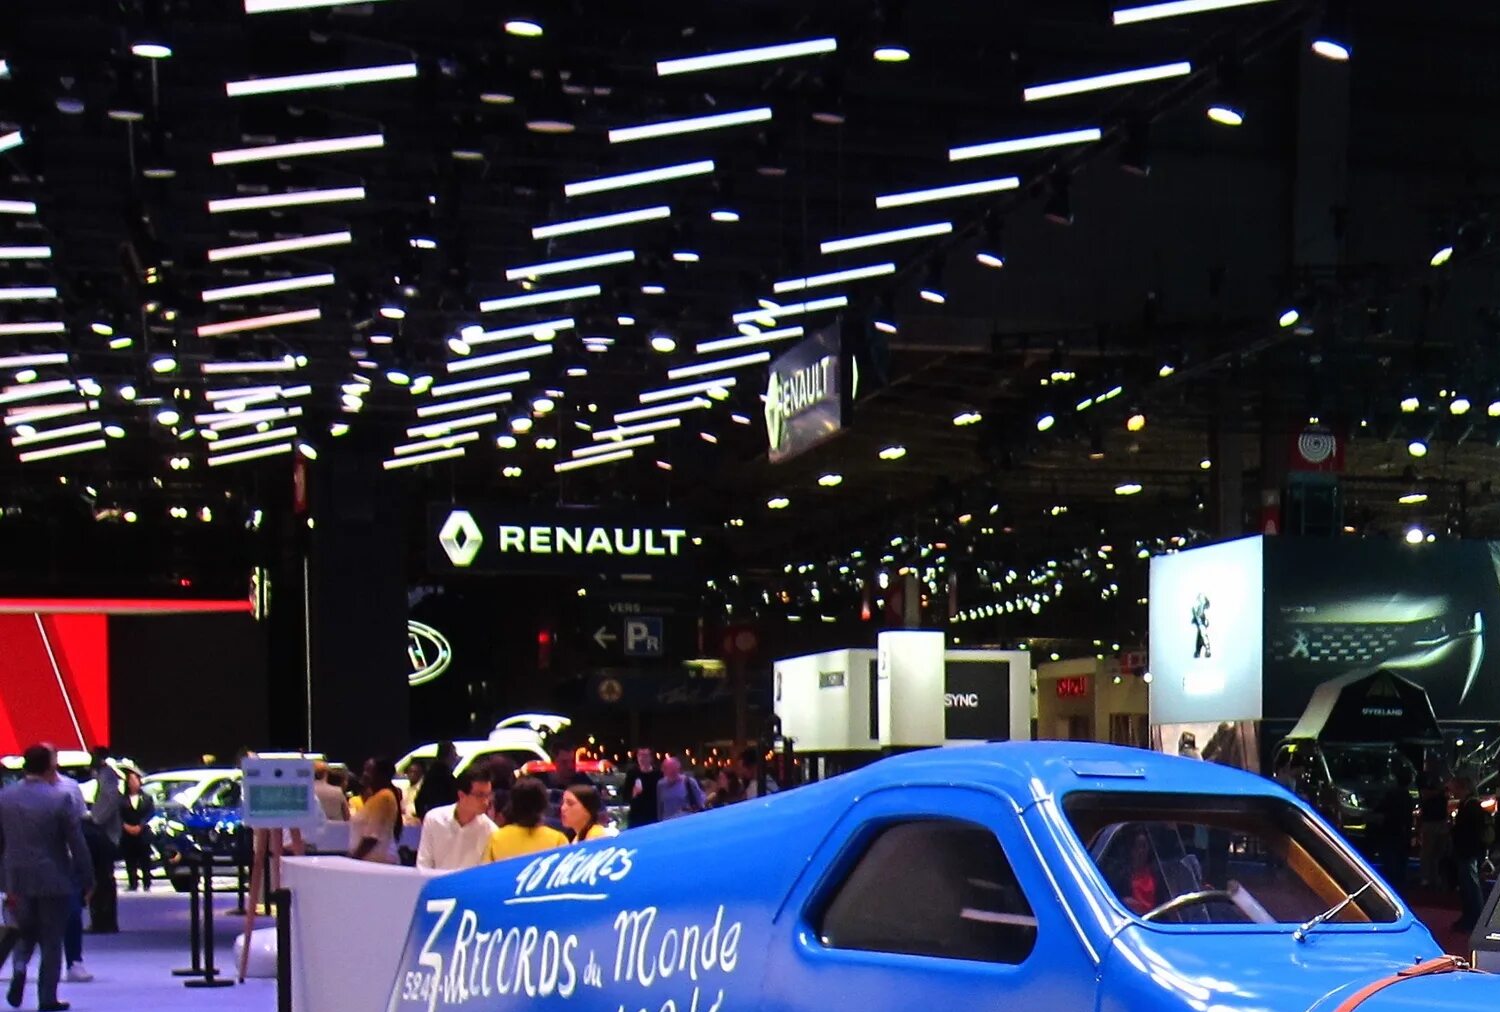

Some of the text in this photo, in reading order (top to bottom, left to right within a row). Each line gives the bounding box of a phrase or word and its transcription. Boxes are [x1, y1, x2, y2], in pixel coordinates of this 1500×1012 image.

[777, 356, 830, 418] RENAULT
[499, 525, 686, 555] RENAULT
[945, 694, 978, 707] SYNC
[449, 908, 578, 999] RECORDS
[583, 950, 602, 988] du
[614, 904, 741, 987] Monde
